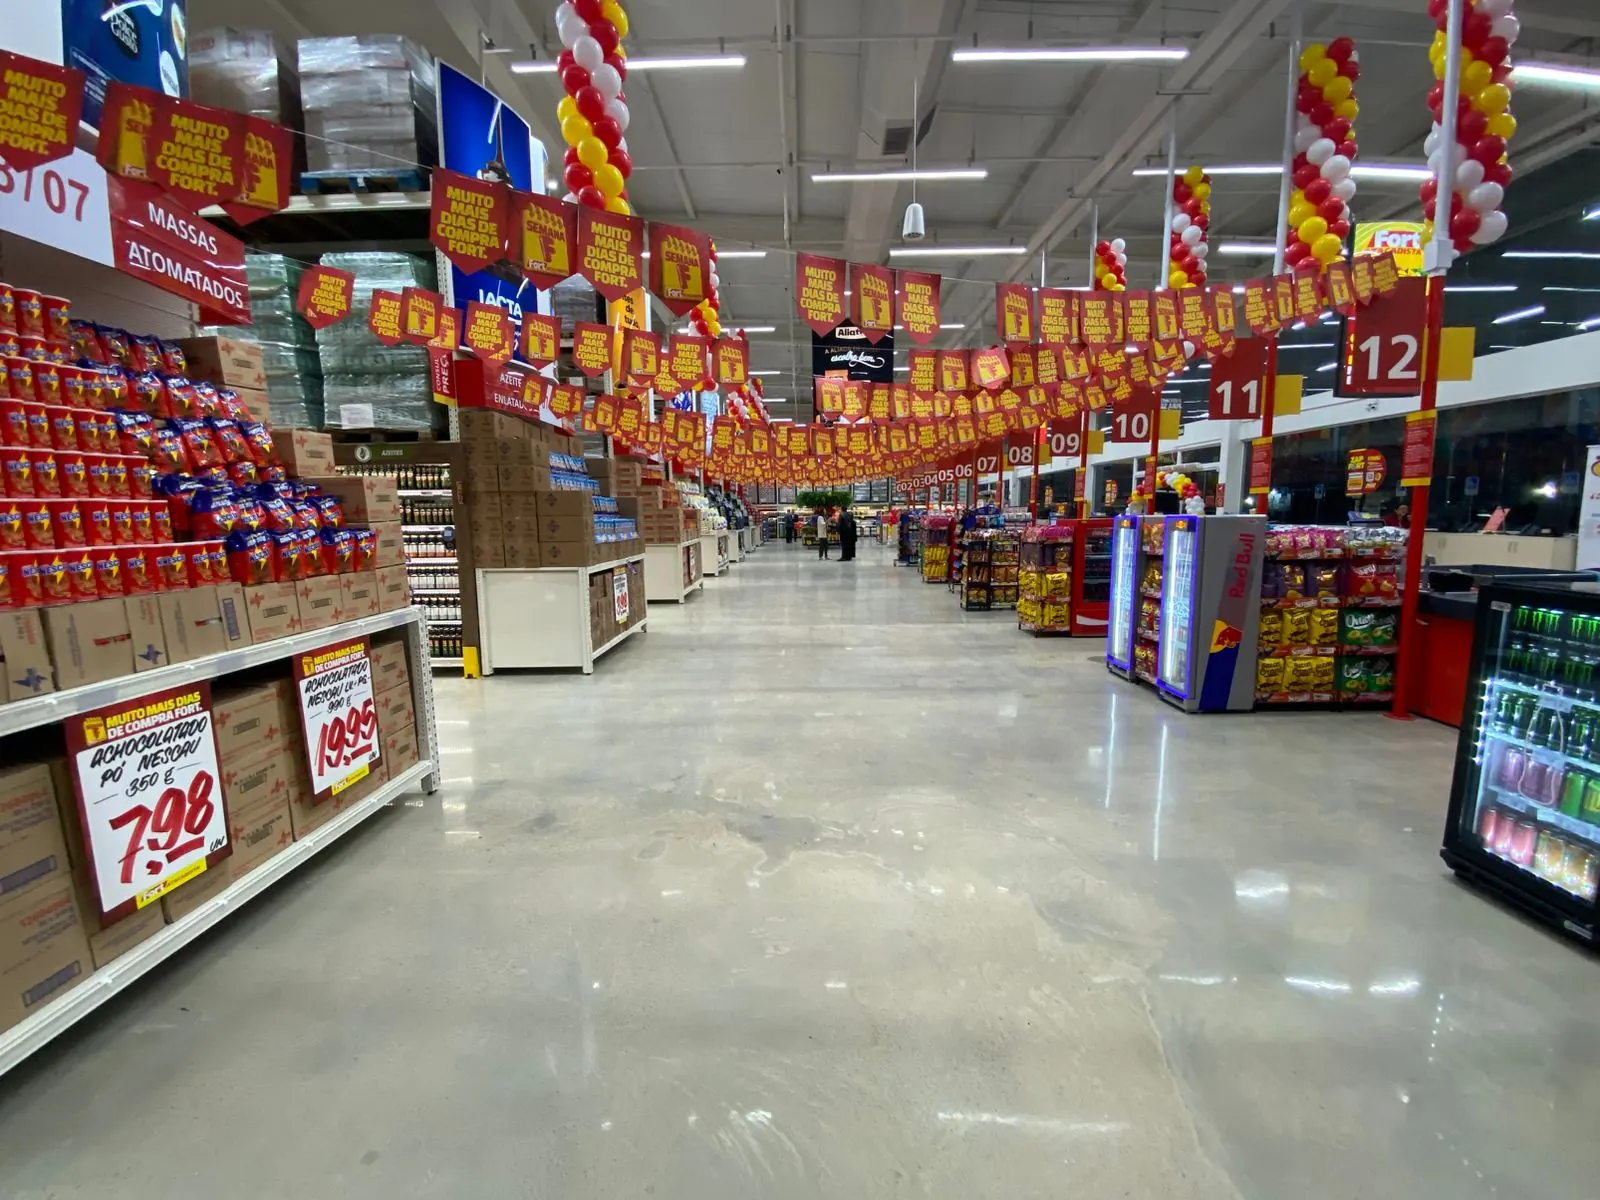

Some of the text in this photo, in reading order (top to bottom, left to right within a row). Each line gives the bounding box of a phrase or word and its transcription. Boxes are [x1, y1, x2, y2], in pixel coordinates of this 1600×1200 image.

[4, 69, 66, 98] MUITO
[8, 86, 58, 111] MAIS
[0, 98, 67, 130] IAS DE
[0, 113, 67, 144] OMPRA
[171, 113, 229, 140] MUITO
[175, 130, 222, 153] MAIS
[161, 141, 206, 166] DIAS
[208, 154, 232, 171] DE
[156, 155, 235, 186] COMPRA
[170, 173, 218, 196] FORT.
[447, 186, 495, 209] MUITO
[451, 199, 489, 220] MAIS
[149, 202, 218, 256] MASSAS
[441, 211, 497, 235] DIAS DE
[591, 221, 631, 241] MUITO
[437, 222, 499, 249] COMPRA
[595, 234, 628, 253] MAIS
[1374, 229, 1421, 249] Fort
[449, 239, 487, 260] FORT.
[587, 245, 635, 267] DIAS DE
[129, 240, 245, 310] ATOMATADOS
[584, 257, 637, 279] COMPRA
[805, 266, 836, 281] MUITO
[595, 271, 628, 288] FORT.
[808, 278, 833, 291] MAIS
[905, 282, 931, 295] MUITO
[667, 288, 683, 298] Fort
[802, 287, 840, 303] DIAS DE
[908, 293, 929, 304] MAIS
[800, 297, 841, 313] COMPRA
[903, 302, 935, 315] DIAS DE
[475, 311, 501, 322] MUITO
[477, 319, 498, 329] MAIS
[808, 310, 834, 322] FORT.
[902, 312, 937, 325] COMPRA
[471, 324, 502, 338] DIAS DE
[838, 328, 862, 337] Aliat
[910, 323, 931, 333] FORT.
[468, 332, 503, 346] COMPRA
[1358, 334, 1418, 380] 12
[1216, 380, 1258, 414] 11
[1116, 413, 1149, 438] 10
[1051, 433, 1080, 453] 09
[977, 456, 997, 472] 07
[1009, 446, 1032, 463] 08
[925, 474, 938, 485] 04
[938, 469, 954, 481] 05
[955, 464, 972, 477] 06
[901, 482, 912, 491] 02
[913, 478, 925, 488] 03
[1235, 533, 1255, 564] Bull
[314, 642, 365, 666] MUITO MAIS DIAS
[315, 650, 366, 674] DE COMPRA FORT.
[305, 661, 368, 694] ACHOCOLATADO
[307, 685, 343, 709] NESCAU
[328, 697, 346, 714] 990
[106, 691, 201, 728] MUITO MAIS DIAS
[107, 702, 203, 740] DE COMPRA FORT.
[90, 715, 208, 769] ACHOCOLATADO
[100, 735, 202, 789] PÓ NESCAU
[125, 772, 160, 798] 350
[209, 835, 226, 852] UN
